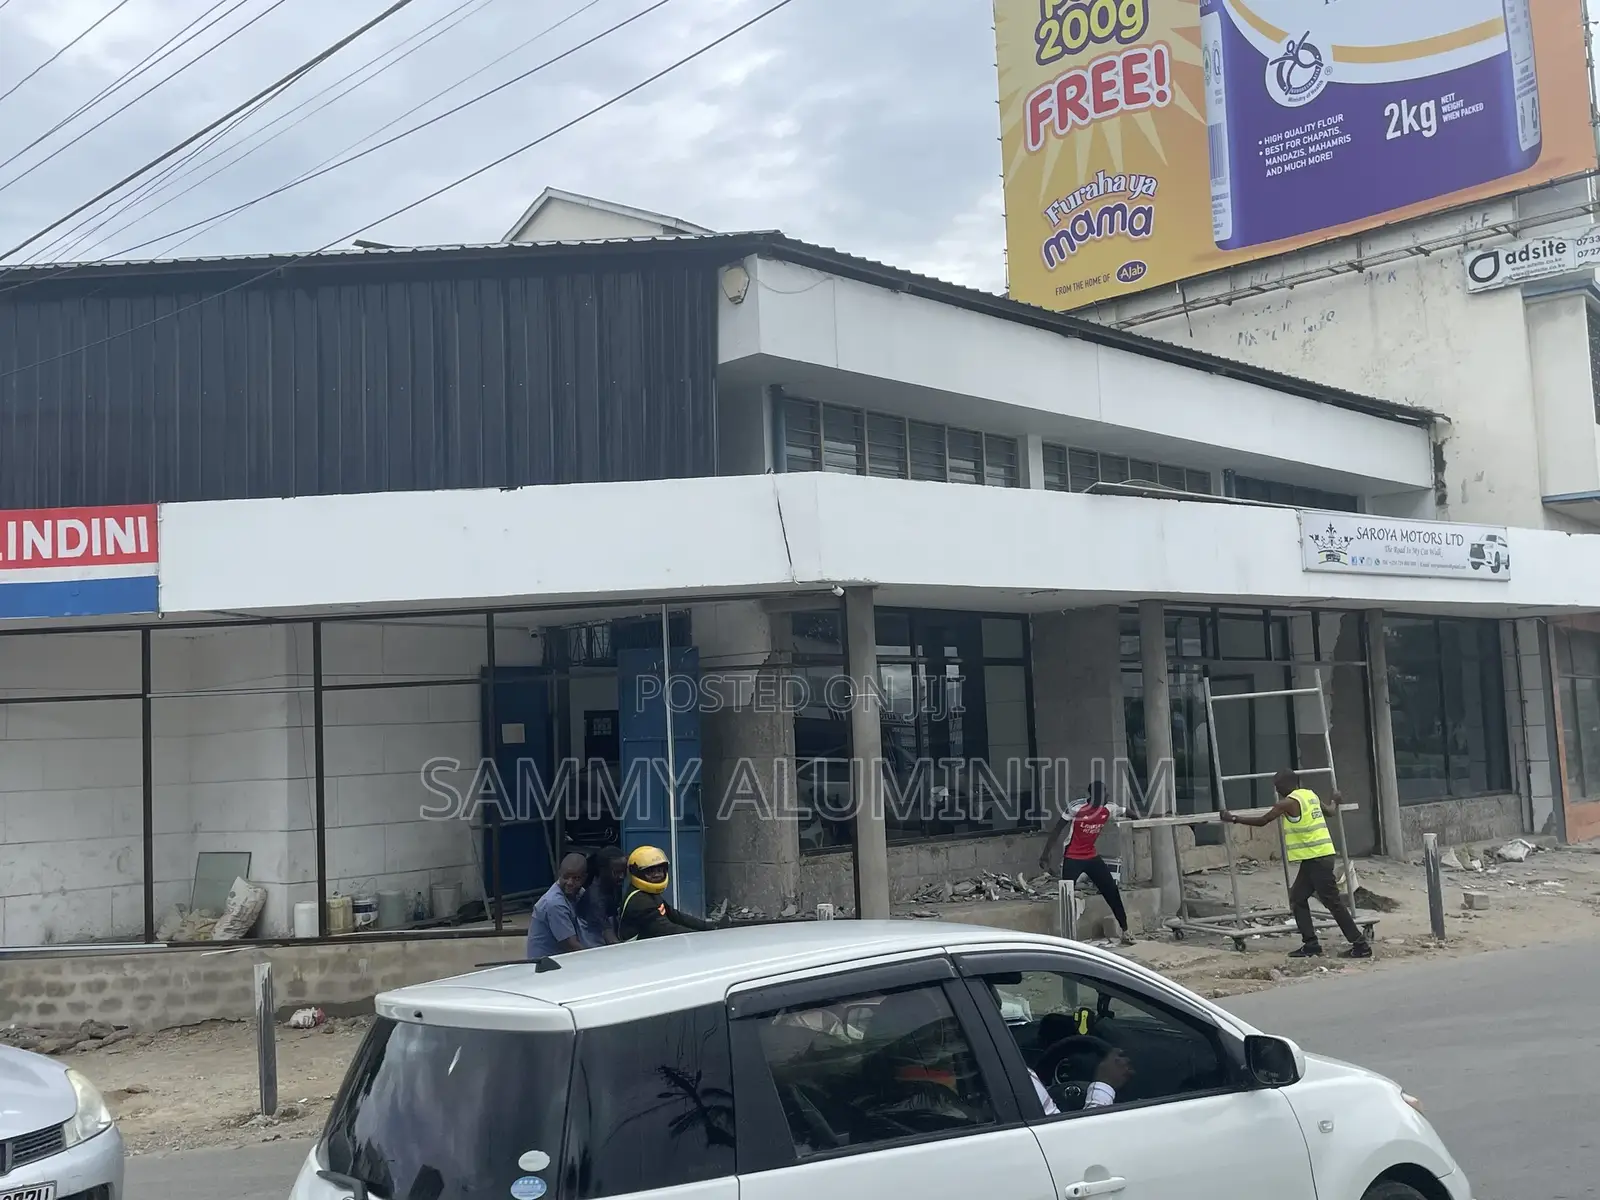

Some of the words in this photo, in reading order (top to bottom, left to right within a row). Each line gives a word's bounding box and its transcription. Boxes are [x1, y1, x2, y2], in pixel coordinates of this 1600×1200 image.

[1037, 0, 1147, 63] 200g
[1028, 47, 1170, 149] FREE!
[1441, 92, 1456, 105] NETT
[1441, 99, 1464, 113] WEIGHT
[1384, 98, 1438, 140] 2kg
[1442, 110, 1460, 122] WHEN
[1460, 102, 1484, 117] PACKED
[1264, 133, 1283, 145] HIGH
[1284, 122, 1316, 139] QUALITY
[1317, 113, 1344, 129] FLOUR
[1265, 143, 1284, 156] BEST
[1286, 138, 1301, 150] FOR
[1308, 134, 1352, 154] MAHAMRIS
[1265, 166, 1283, 178] AND
[1284, 159, 1307, 173] MUCH
[1308, 151, 1333, 165] MORE!
[1044, 169, 1127, 227] Furaha
[1043, 202, 1154, 268] mama
[1505, 240, 1567, 265] adsite
[1055, 286, 1072, 296] FROM
[1073, 280, 1084, 291] THE
[1084, 276, 1102, 288] HOME
[1102, 273, 1111, 283] OF
[0, 516, 149, 561] INDINI
[1356, 526, 1398, 542] SAROYA
[1400, 529, 1443, 545] MOTORS
[1445, 534, 1464, 547] LTD
